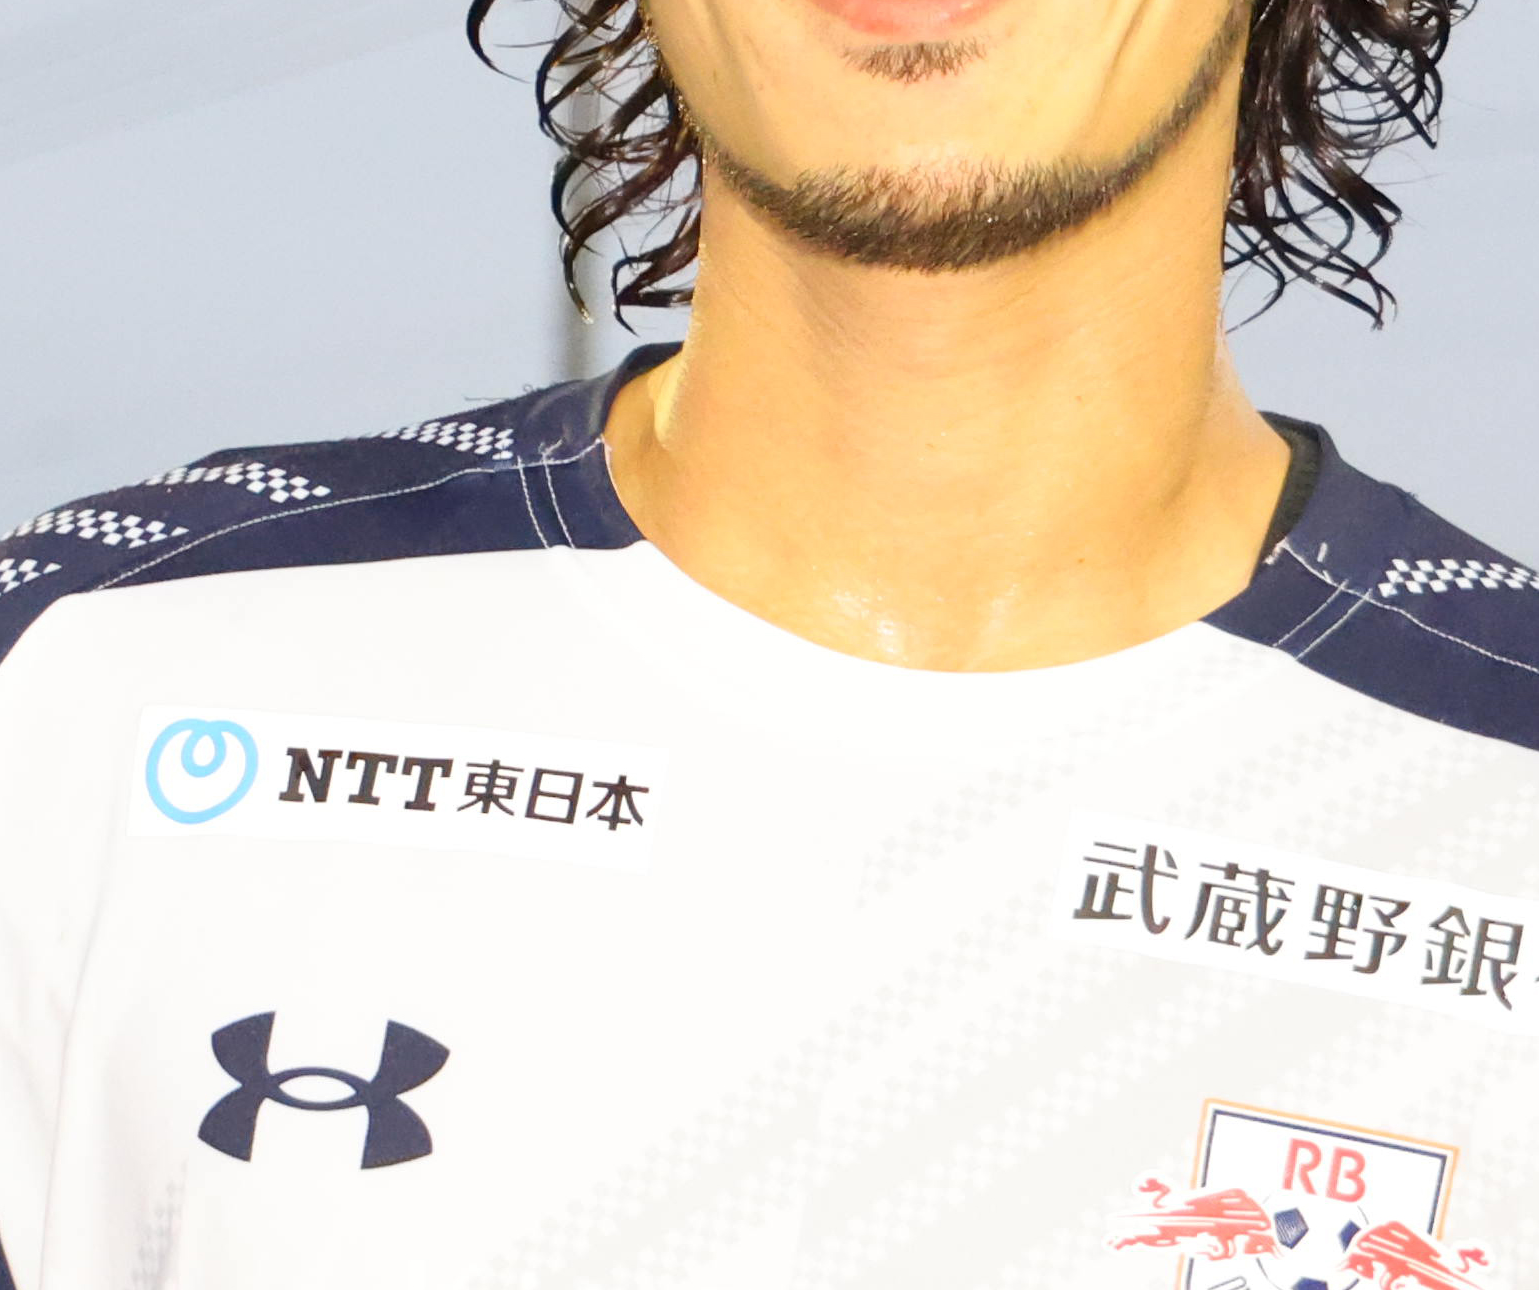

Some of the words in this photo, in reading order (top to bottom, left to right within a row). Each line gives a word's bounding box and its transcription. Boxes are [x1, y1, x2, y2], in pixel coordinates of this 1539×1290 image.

[278, 746, 650, 832] NTT東日本
[1282, 1137, 1367, 1203] RB
